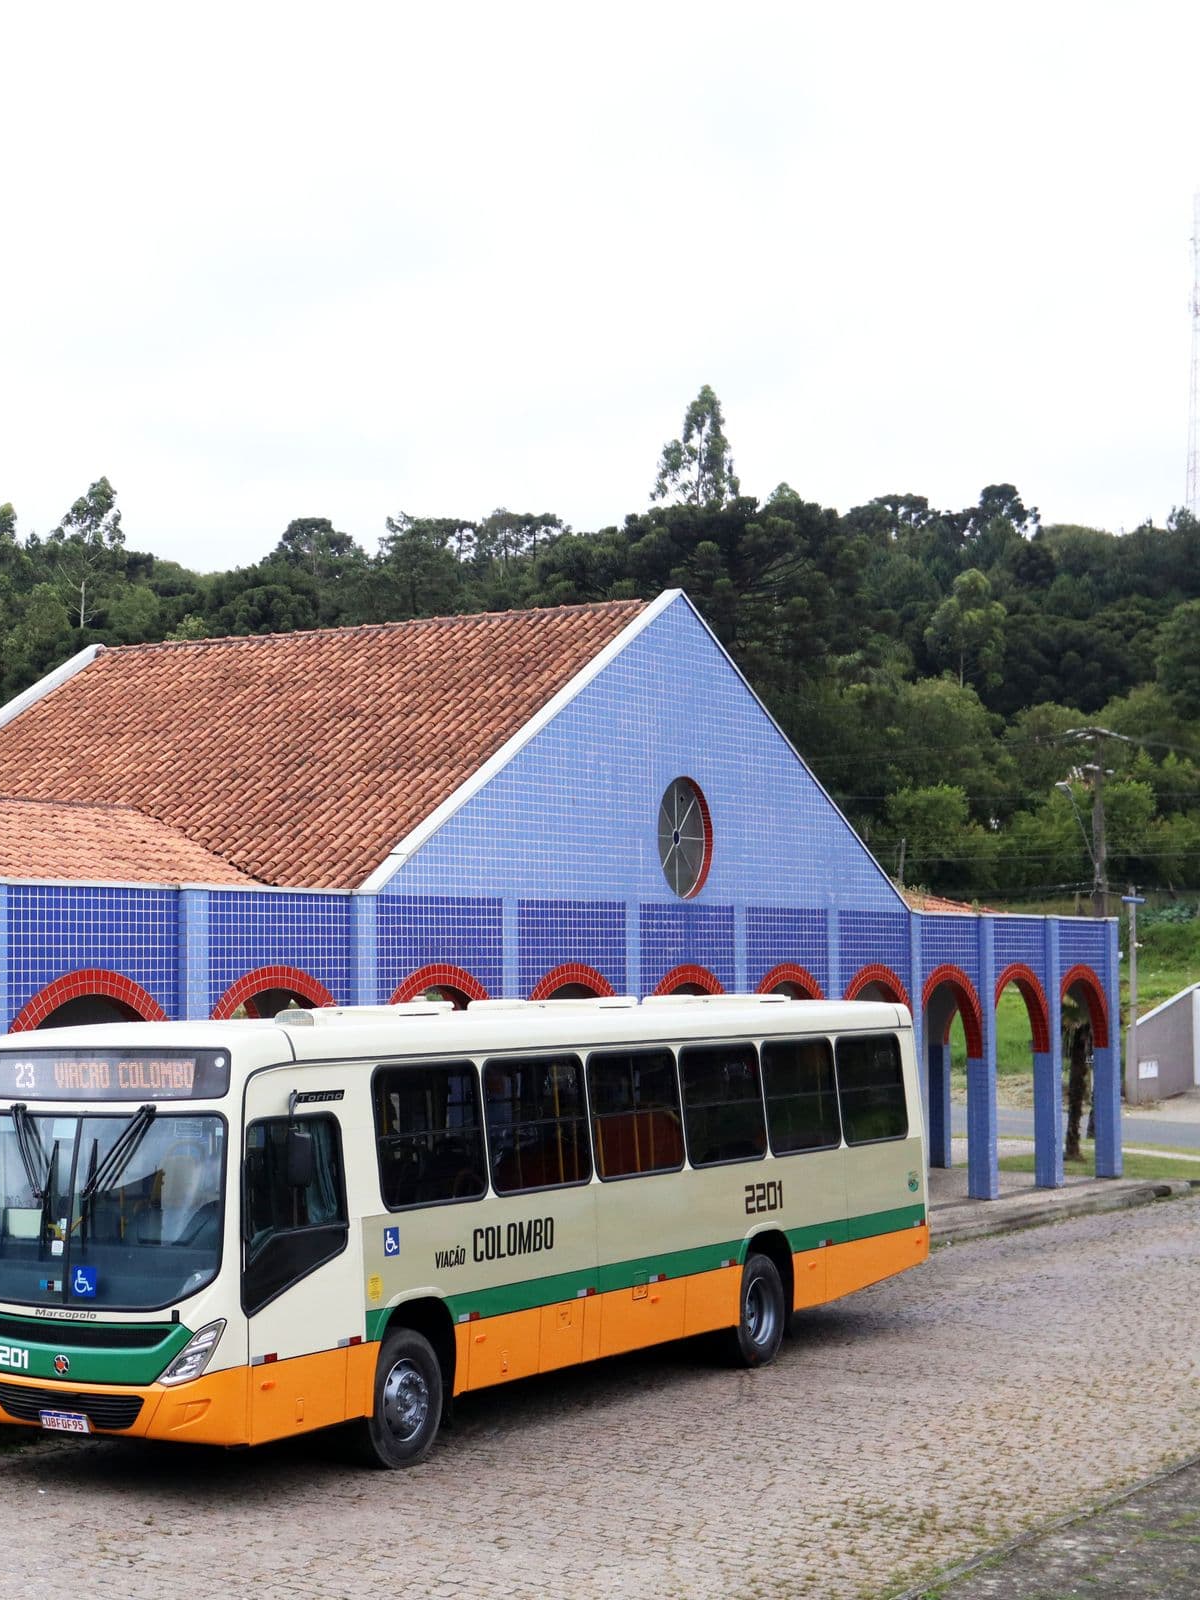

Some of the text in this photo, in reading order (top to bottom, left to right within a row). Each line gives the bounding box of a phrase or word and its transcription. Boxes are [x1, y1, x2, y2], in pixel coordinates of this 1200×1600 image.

[14, 1063, 35, 1088] 23
[118, 1062, 194, 1088] COLOMBO
[299, 1092, 343, 1102] Torino
[745, 1180, 783, 1214] 2201
[473, 1217, 554, 1263] COLOMBO
[35, 1309, 97, 1320] Marcopolo
